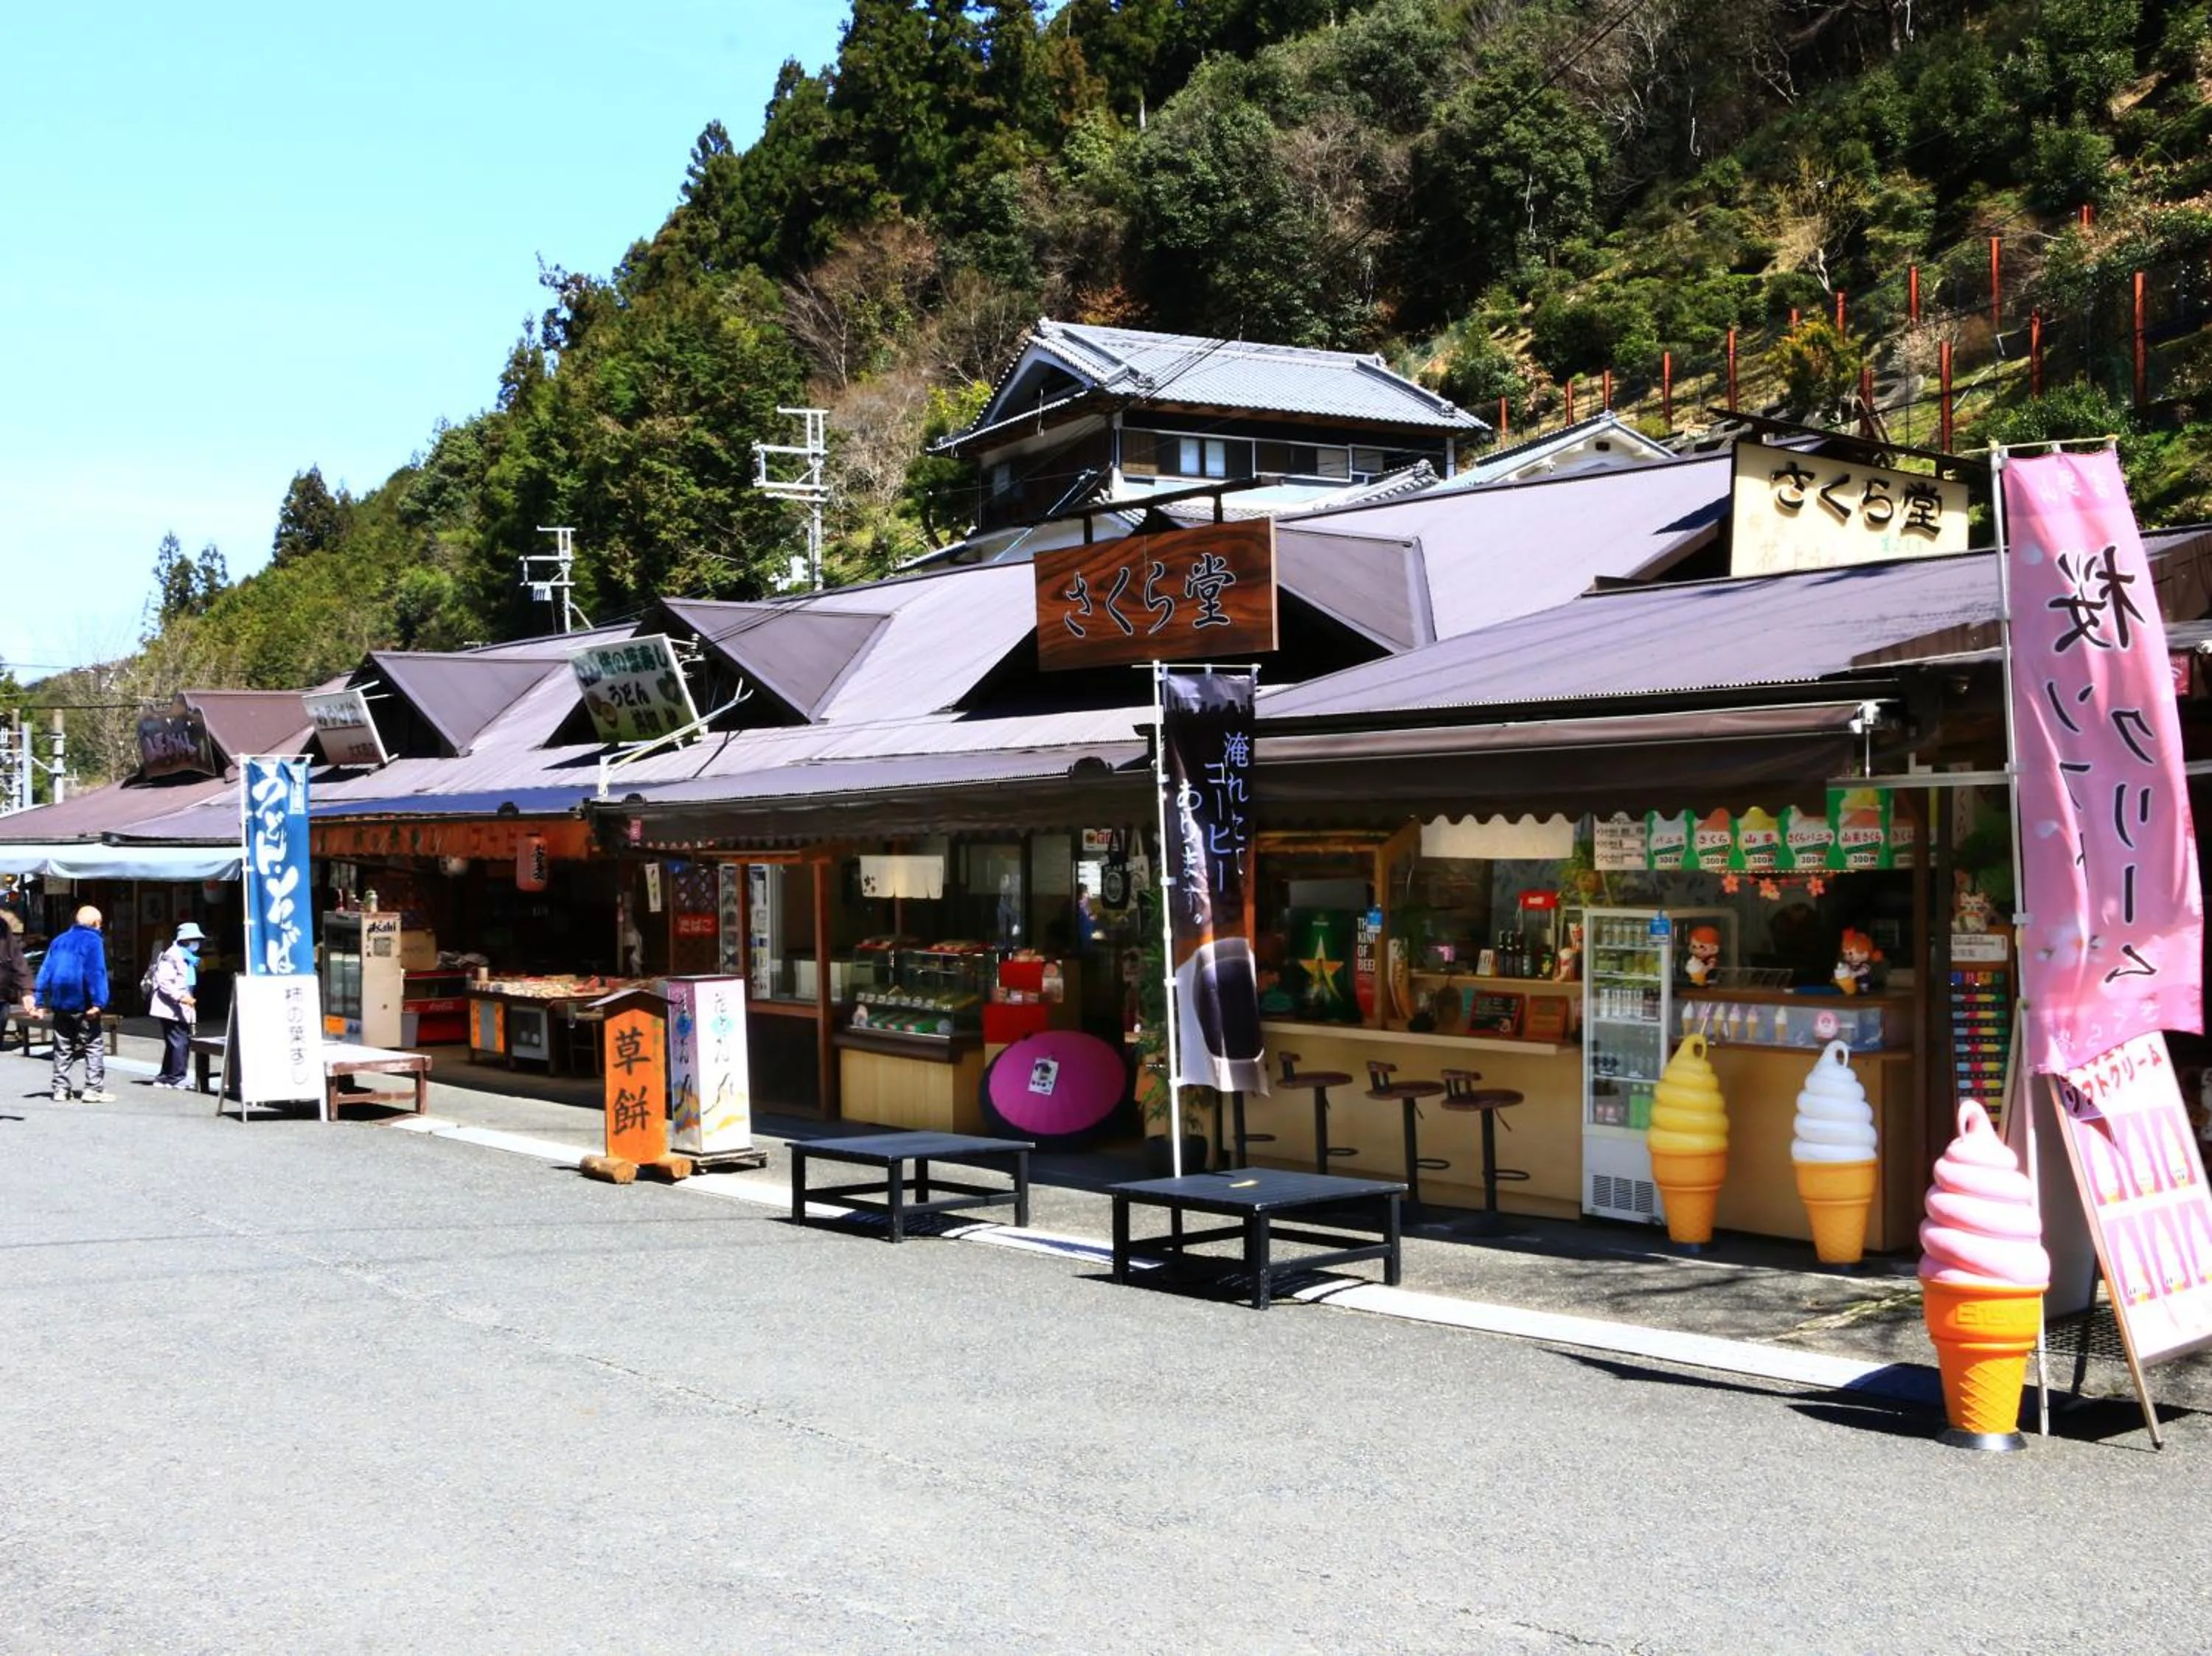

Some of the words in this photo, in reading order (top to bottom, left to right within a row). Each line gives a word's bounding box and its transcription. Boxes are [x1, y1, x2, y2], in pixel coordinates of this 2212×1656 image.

[1771, 461, 1944, 537] さくら堂
[1064, 552, 1237, 638] さくら堂
[608, 680, 652, 708] うどん
[1203, 762, 1232, 893] コーヒー
[1698, 834, 1728, 844] さくら
[1853, 854, 1877, 863] 300円
[612, 1025, 652, 1137] 草餅
